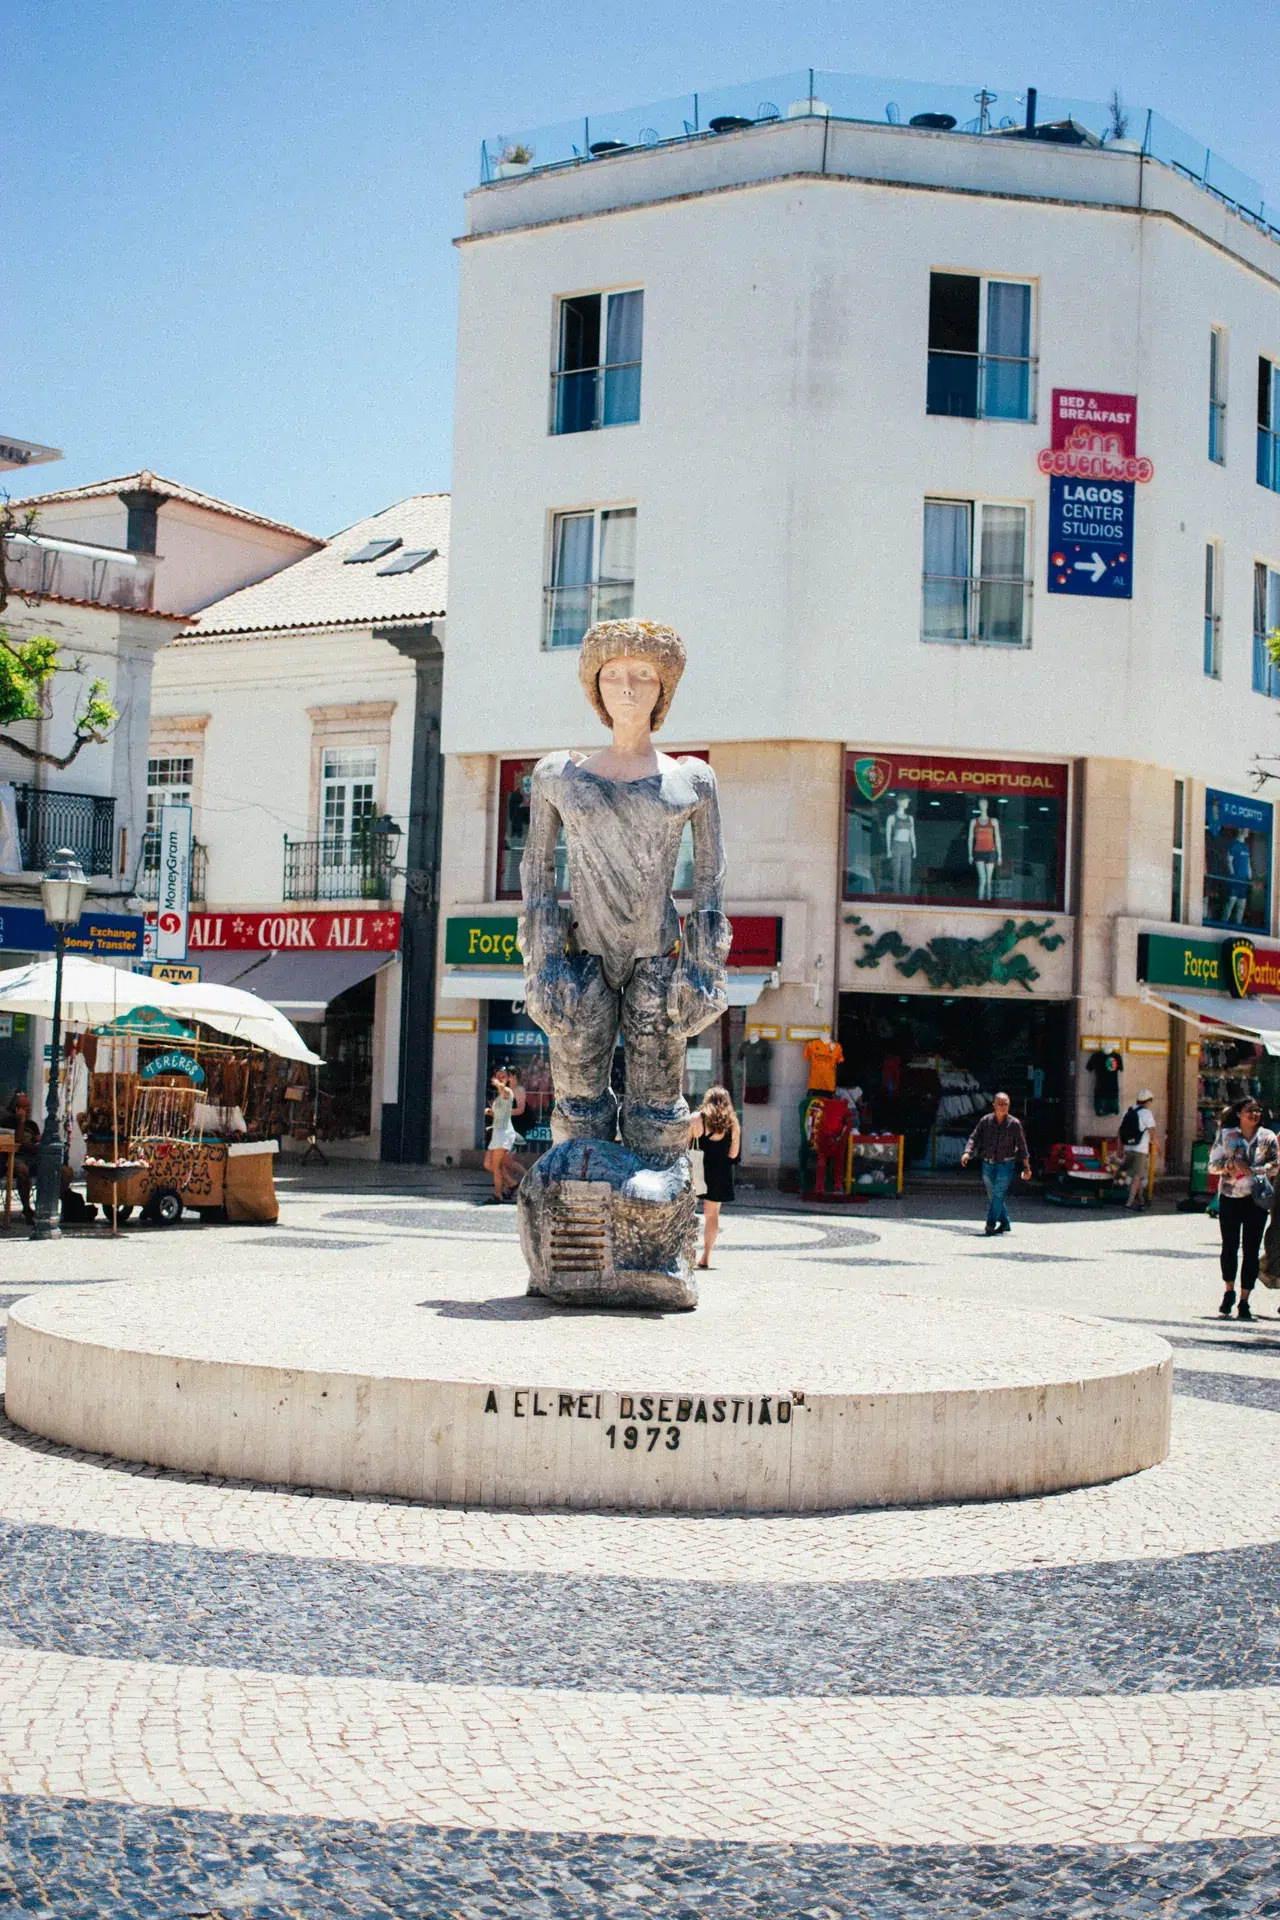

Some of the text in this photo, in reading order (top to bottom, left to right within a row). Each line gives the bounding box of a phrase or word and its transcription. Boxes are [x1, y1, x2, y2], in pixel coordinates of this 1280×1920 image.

[1059, 396, 1098, 410] BED &
[1059, 408, 1132, 424] BREAKFAST
[1063, 484, 1124, 504] LAGOS
[1063, 503, 1124, 521] CENTER
[1062, 521, 1124, 539] STUDIOS
[897, 766, 1055, 790] FORÇA PORTUGAL
[165, 831, 179, 910] MoneyGram
[89, 926, 138, 940] Exchange
[188, 917, 368, 948] ALL CORK ALL
[96, 939, 136, 951] Transfer
[159, 968, 193, 980] ATM
[1184, 951, 1218, 985] Força
[504, 1032, 545, 1046] UEFA
[145, 1055, 199, 1075] TERERES
[484, 1389, 499, 1414] A
[605, 1425, 682, 1452] 1973
